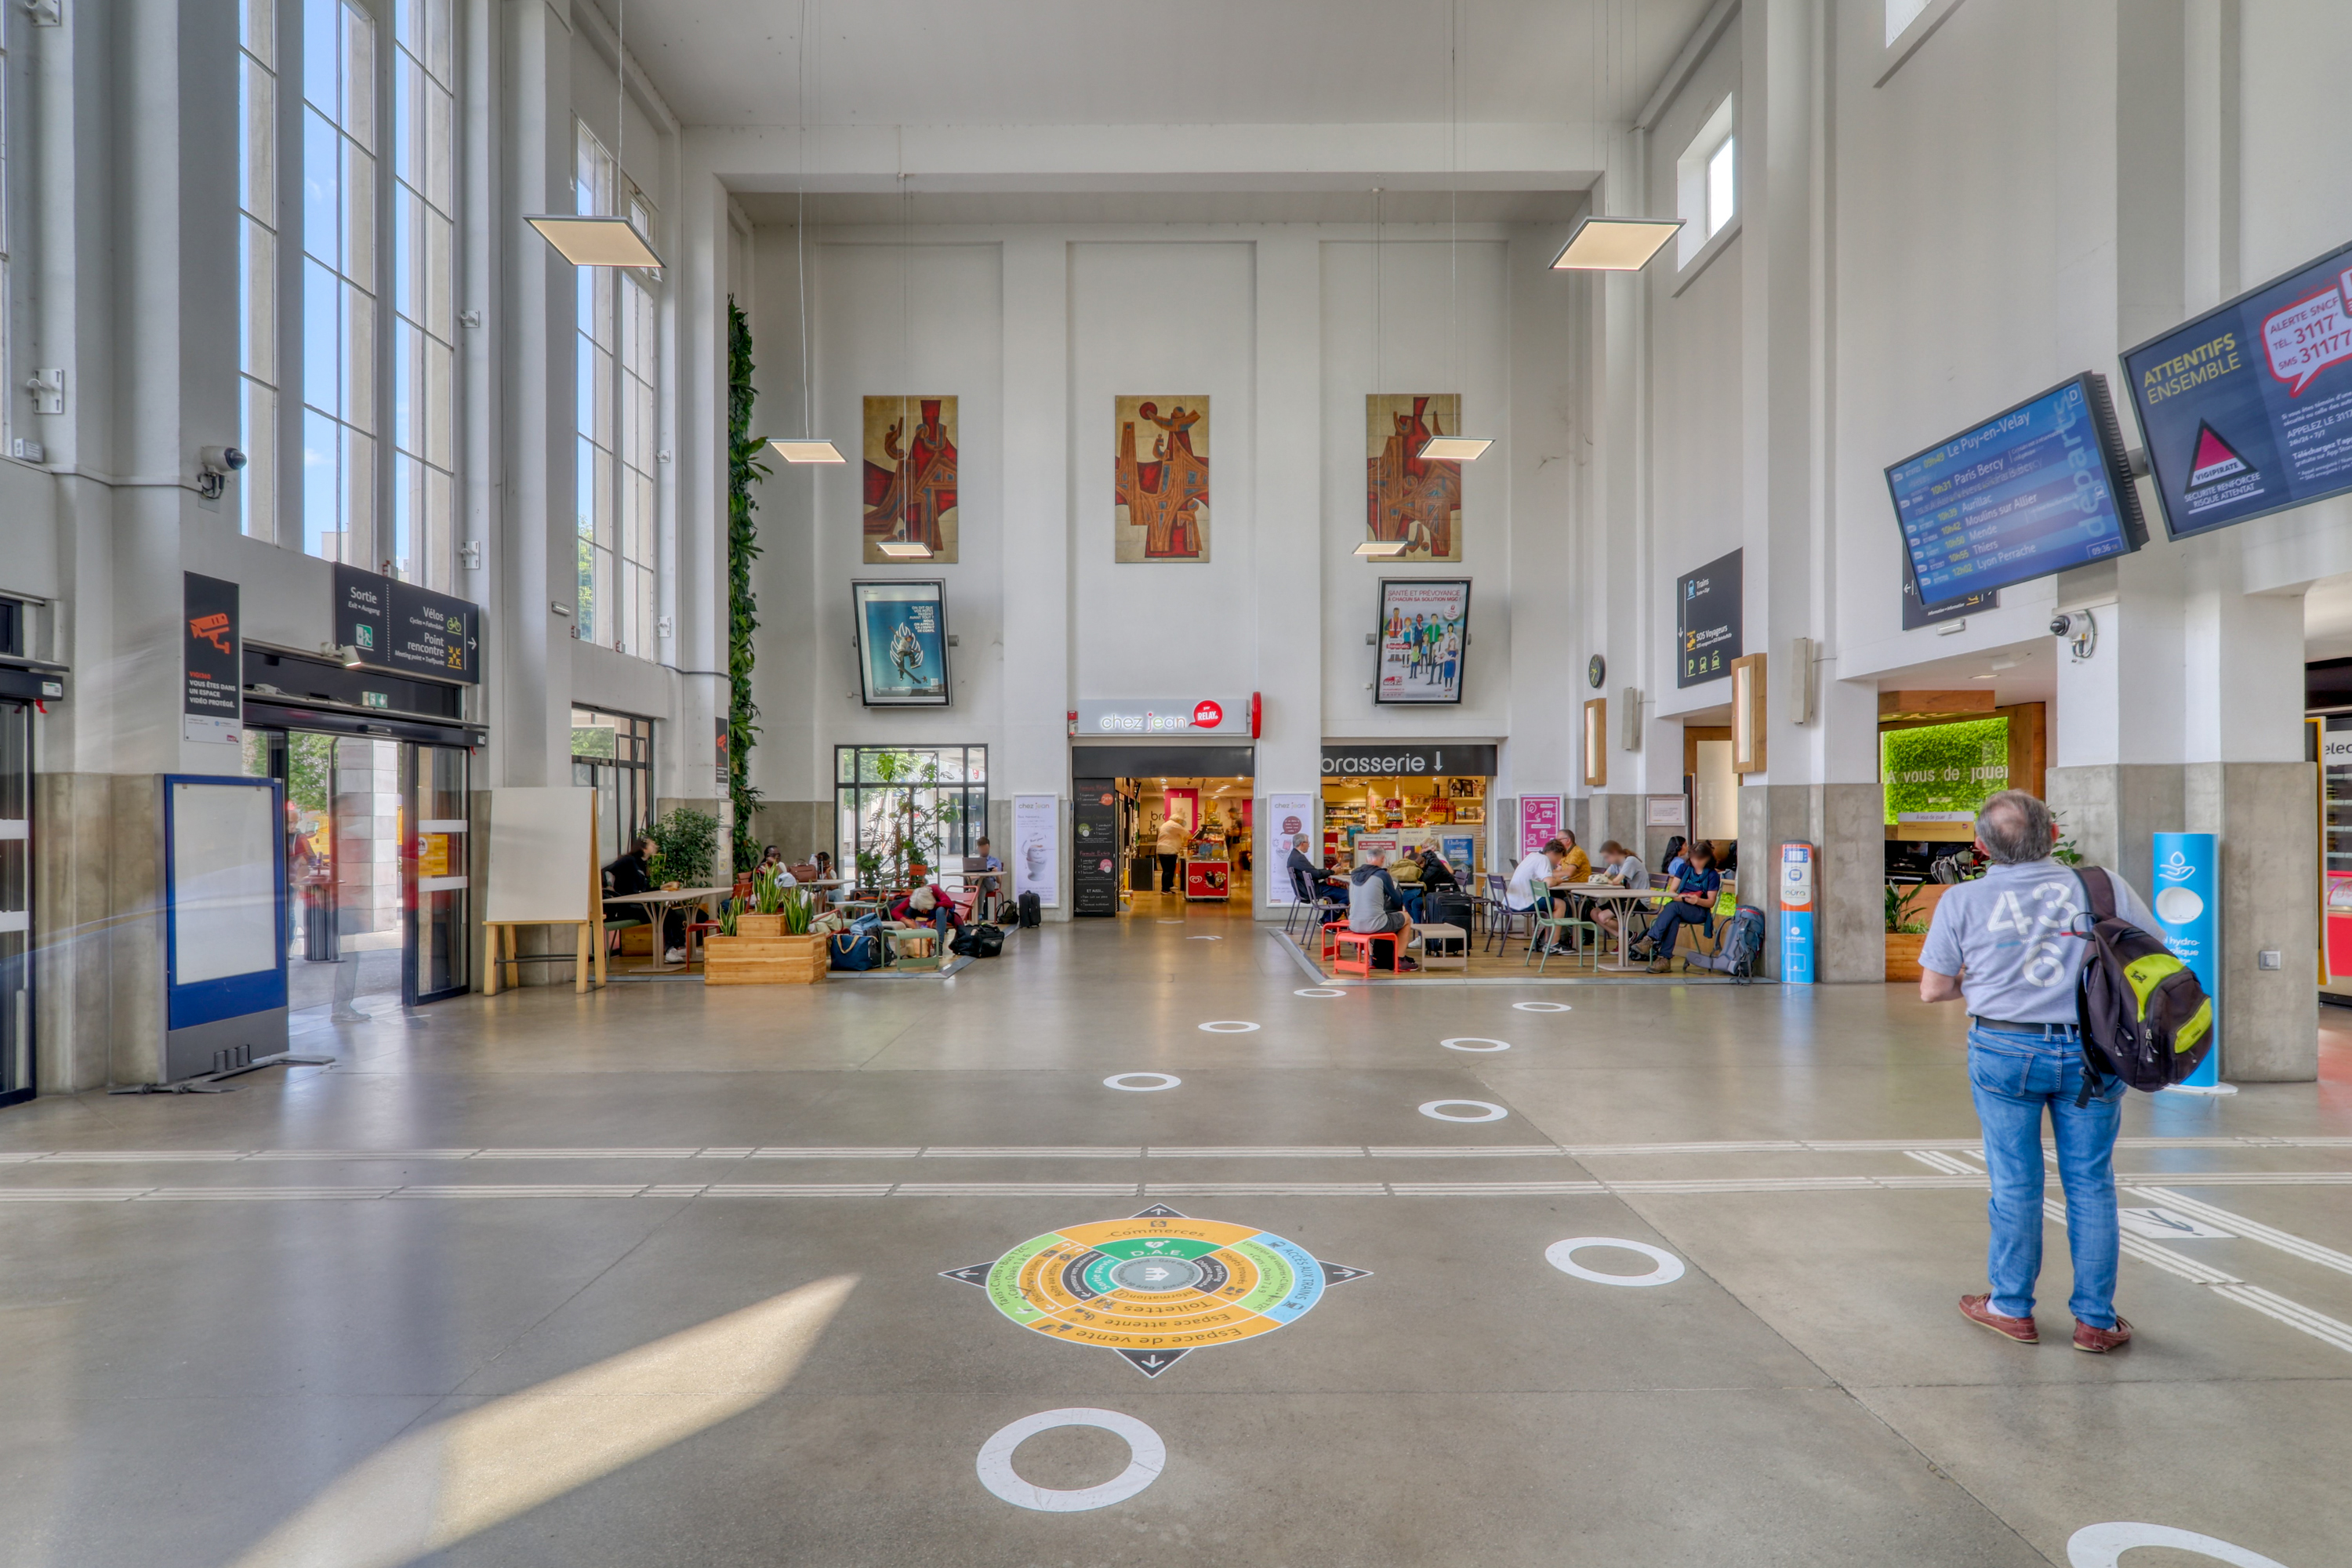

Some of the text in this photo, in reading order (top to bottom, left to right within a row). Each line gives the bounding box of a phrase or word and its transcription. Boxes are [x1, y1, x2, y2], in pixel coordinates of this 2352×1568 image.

[2270, 296, 2339, 334] ALERTE SNCF
[2144, 332, 2236, 387] ATTENTIFS
[2278, 358, 2297, 370] SMS
[2147, 351, 2241, 405] ENSEMBLE
[1947, 445, 1958, 458] Le
[1961, 412, 2030, 452] Puy-en-Velay
[2288, 419, 2322, 438] APPELEZ
[2324, 416, 2336, 426] LE
[1930, 456, 2004, 495] 10h31 Paris Bercy
[2195, 462, 2239, 481] VIGIPIRATE
[2184, 472, 2261, 503] SECURITE RENFORCEE
[2193, 484, 2255, 507] RISQUE ATTENTAT
[1962, 493, 1992, 513] Aurillac
[1965, 508, 1998, 527] Moulins
[1999, 503, 2013, 514] sur
[2014, 493, 2038, 510] Allier
[1969, 524, 1998, 541] Mende
[1973, 540, 1998, 556] Thiers
[1976, 555, 1998, 571] Lyon
[1998, 543, 2037, 564] Perrache
[1697, 579, 1709, 590] Trains
[350, 586, 377, 604] Sortie
[361, 604, 380, 615] Ausgang
[423, 606, 444, 622] Vélos
[409, 617, 423, 626] Cycles
[424, 632, 445, 647] Point
[1696, 625, 1728, 642] SOS Voyageurs
[394, 650, 411, 660] Meeting
[411, 653, 422, 662] point
[408, 641, 444, 656] rencontre
[206, 681, 220, 689] ÊTES
[189, 696, 208, 705] VIDÉO
[199, 689, 220, 698] ESPACE
[1101, 712, 1186, 732] chez jean
[1320, 753, 1425, 773] brasserie
[1903, 771, 1935, 783] vous
[1944, 765, 1960, 781] de
[2024, 942, 2065, 988] 6
[1111, 1229, 1206, 1237] Commerces
[1011, 1246, 1029, 1255] T2C
[1242, 1241, 1270, 1255] Location
[999, 1256, 1014, 1265] Bus
[1196, 1260, 1213, 1274] Dépose
[1221, 1253, 1247, 1284] Objets trouvés
[1005, 1266, 1019, 1280] Quais
[1091, 1259, 1115, 1290] Sortie parvis
[1214, 1265, 1225, 1282] Parking
[1263, 1268, 1272, 1280] Quais
[1283, 1248, 1315, 1300] ACCÈS AUX TRAINS
[994, 1291, 1010, 1305] Taxis
[1129, 1290, 1198, 1301] Information
[1123, 1301, 1214, 1314] Toilettes
[1253, 1302, 1270, 1311] T2C
[1105, 1313, 1232, 1328] Espace attente
[1076, 1328, 1243, 1345] Espace de vente
